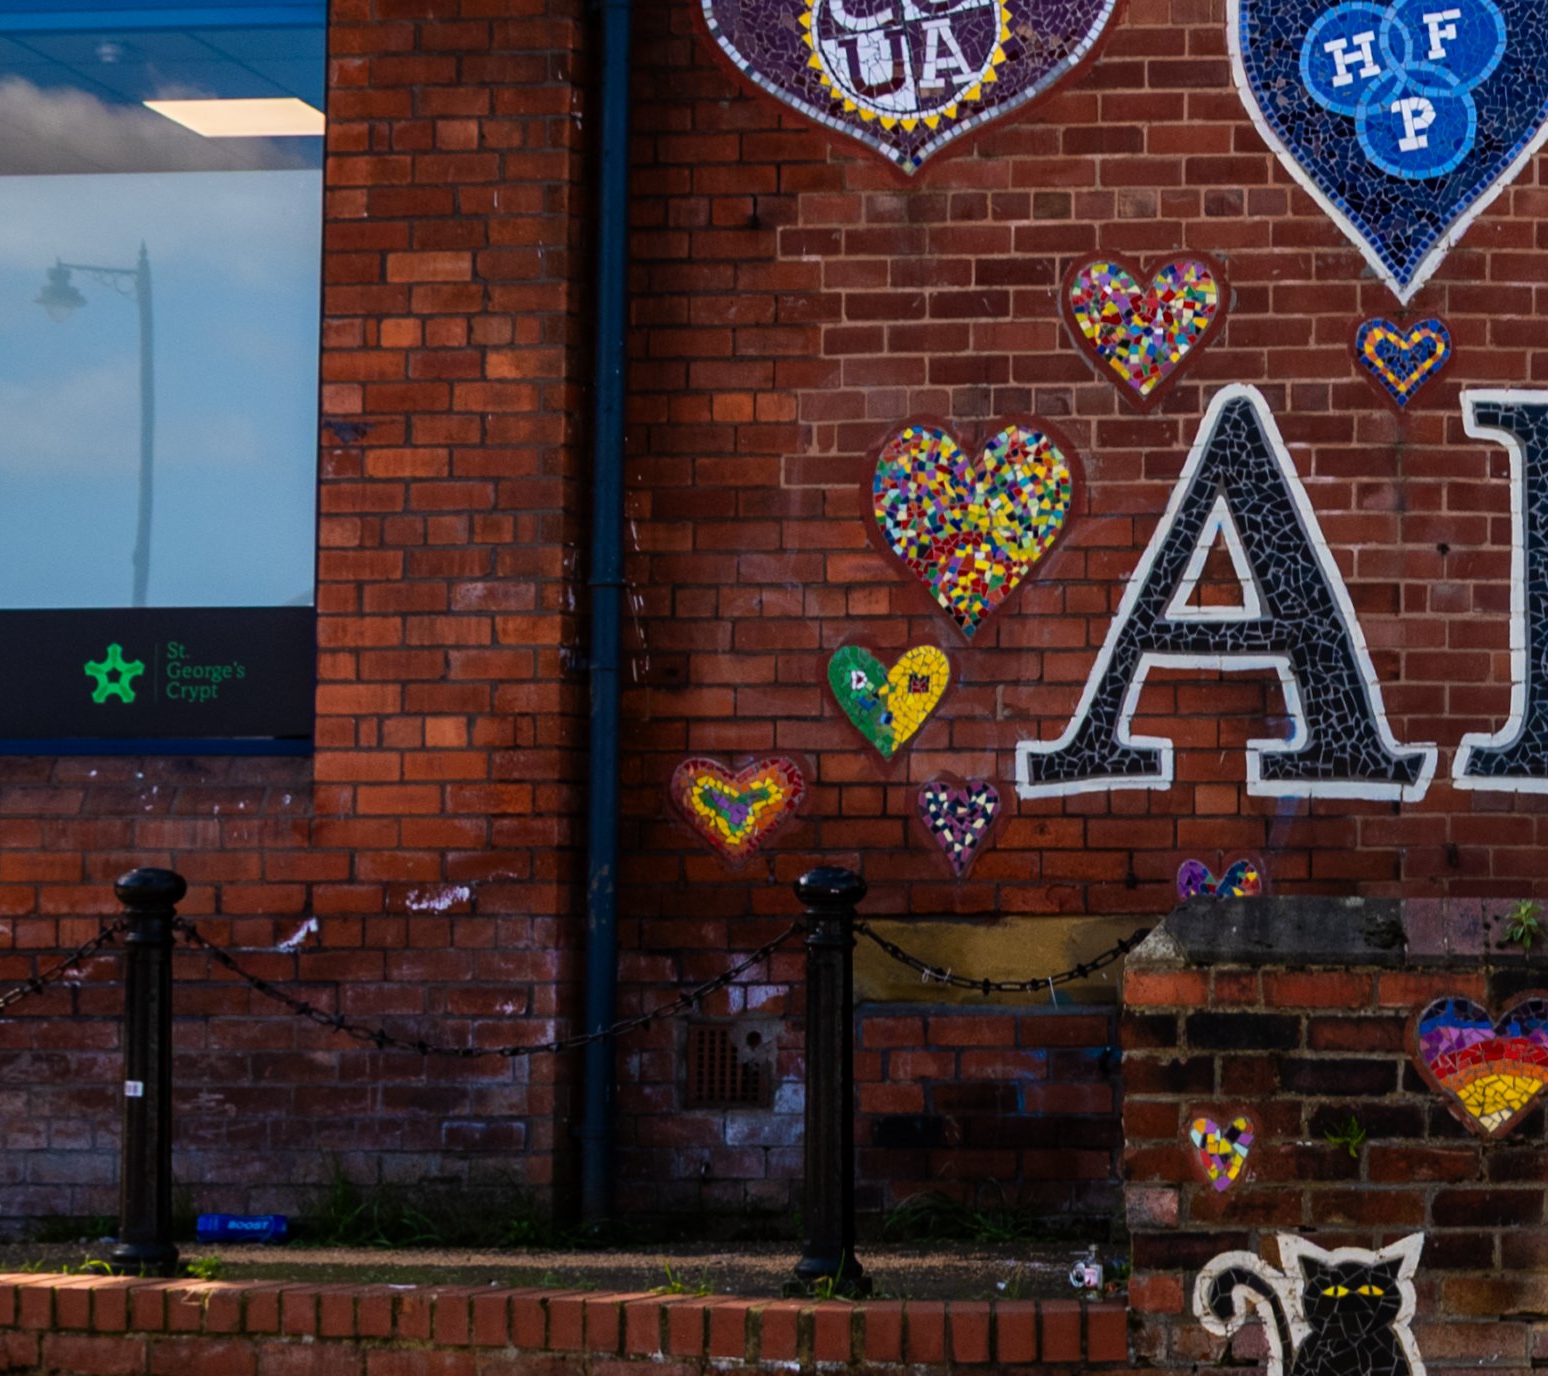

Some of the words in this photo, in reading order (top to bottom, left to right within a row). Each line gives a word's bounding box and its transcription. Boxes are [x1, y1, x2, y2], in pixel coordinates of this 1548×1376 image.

[167, 641, 190, 659] St.
[166, 660, 246, 683] George's
[166, 681, 219, 703] Crypt
[228, 1220, 269, 1230] BOOST
